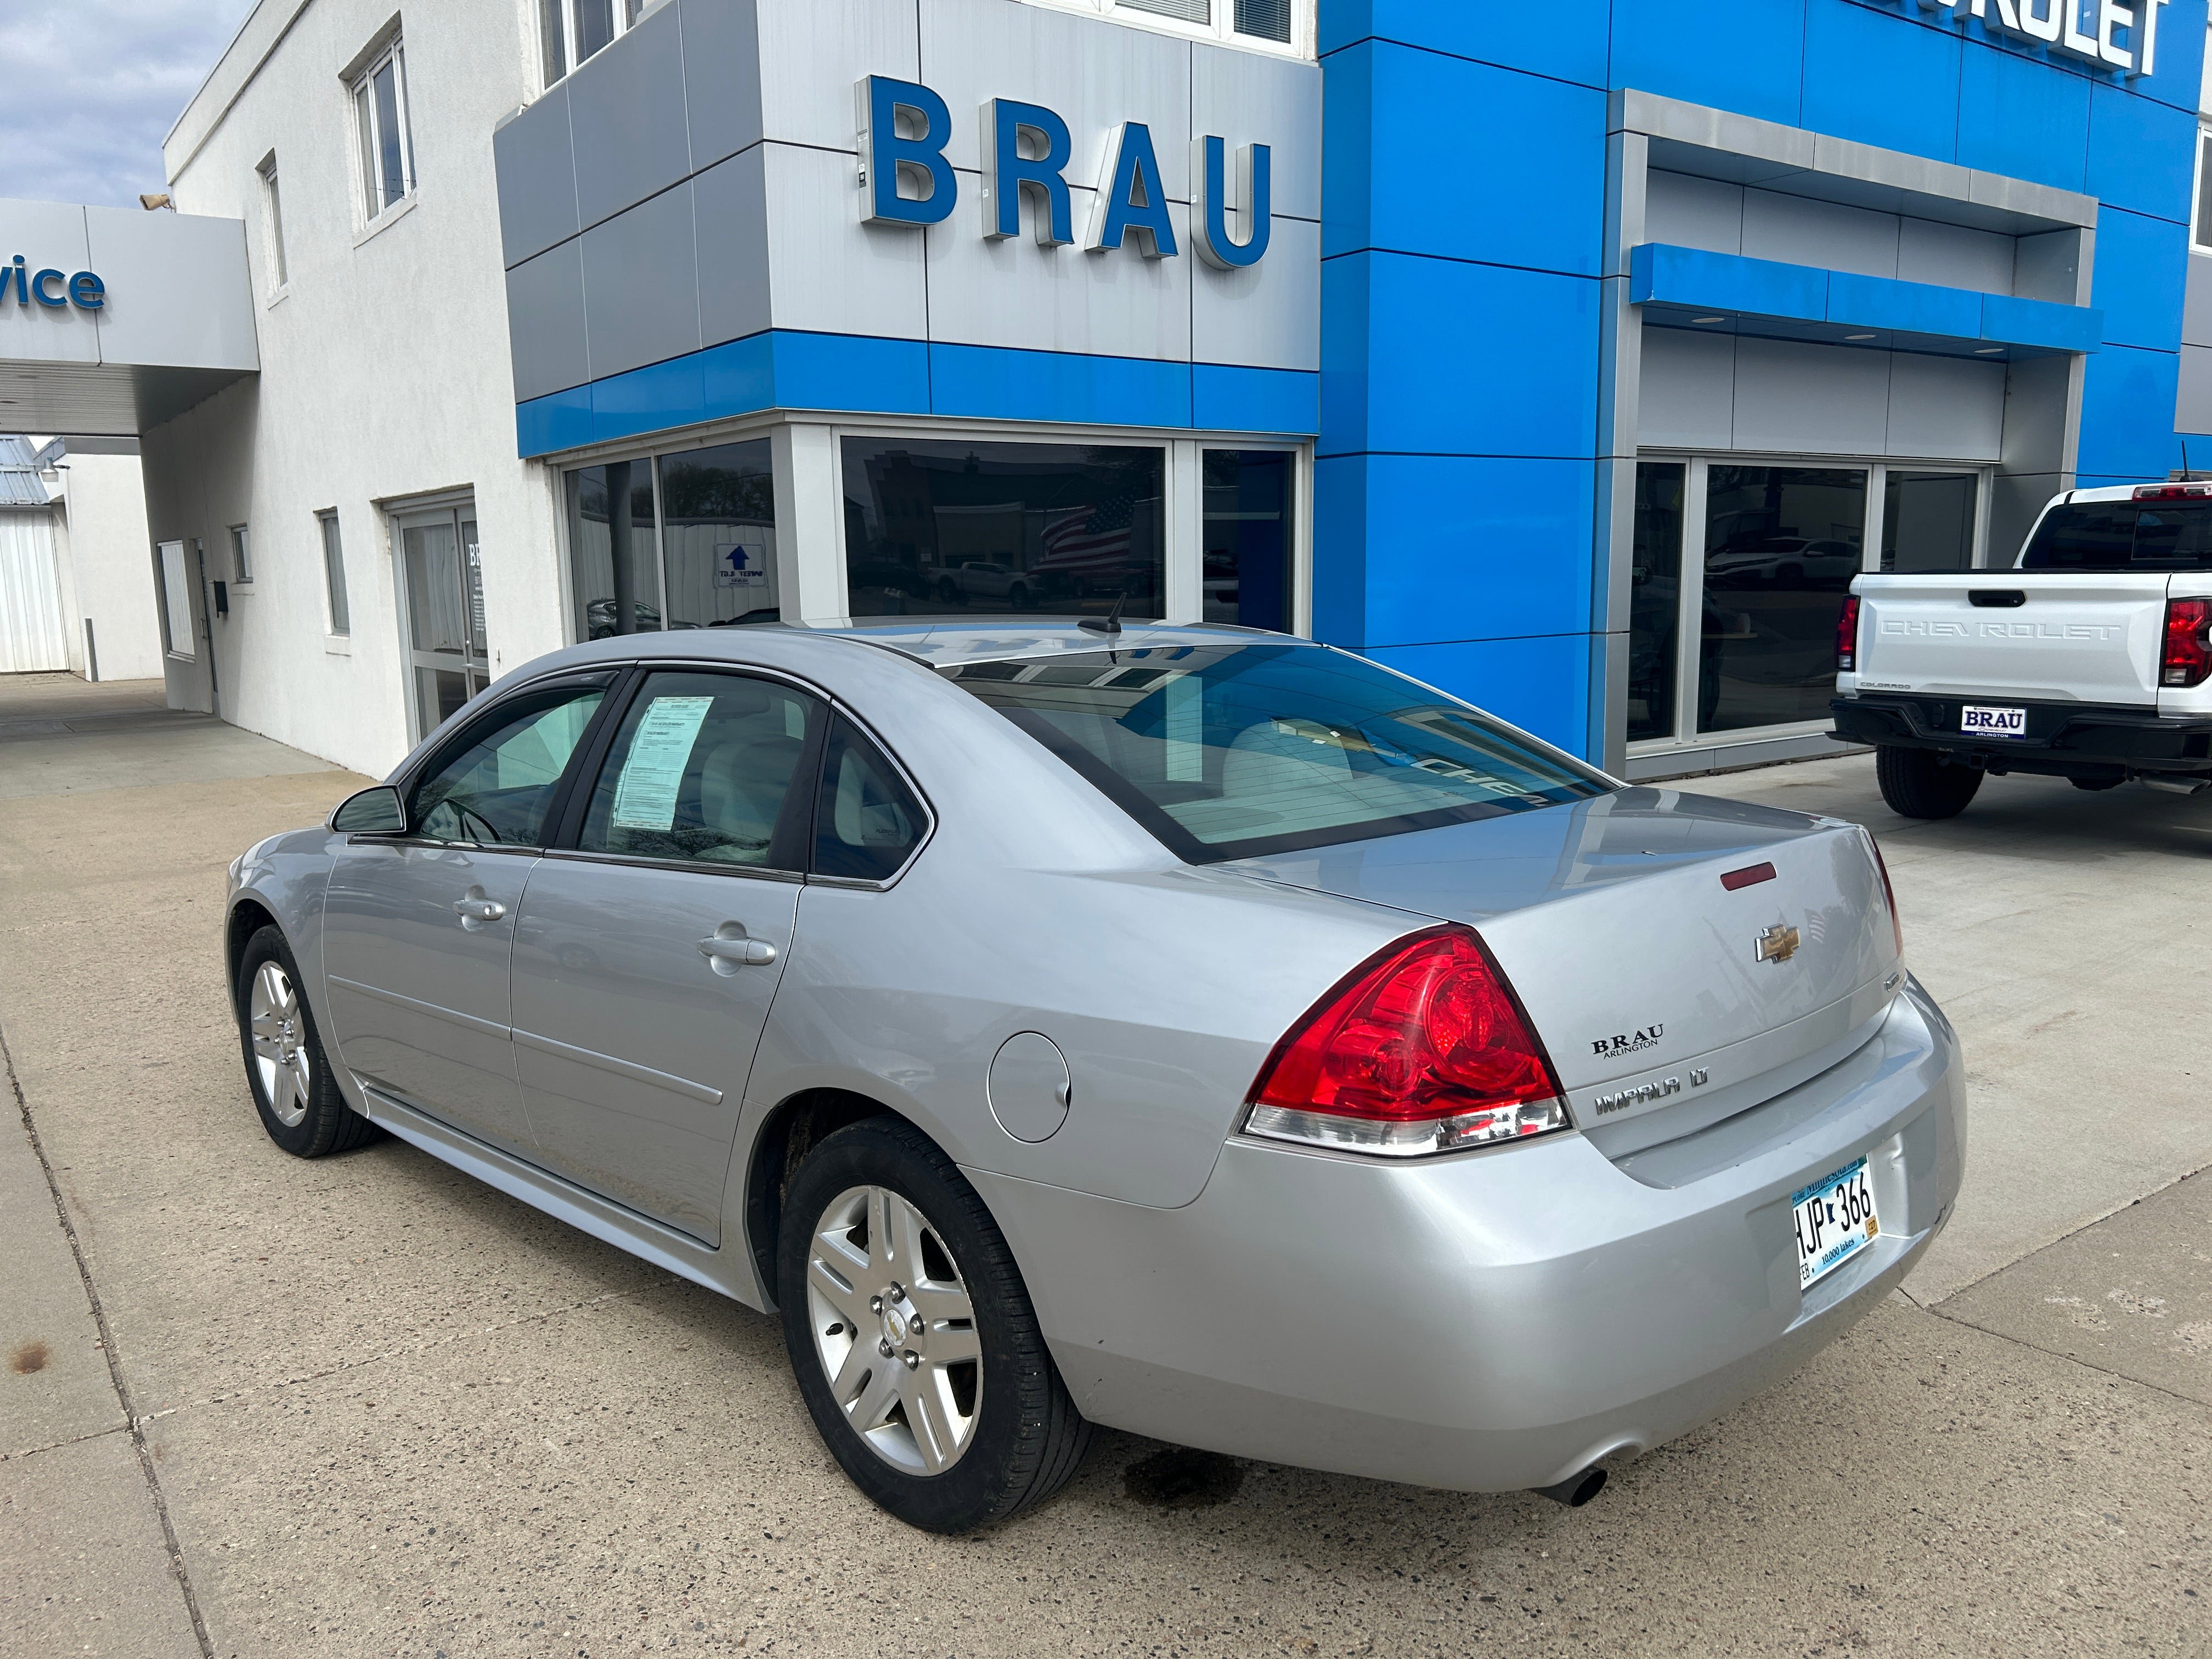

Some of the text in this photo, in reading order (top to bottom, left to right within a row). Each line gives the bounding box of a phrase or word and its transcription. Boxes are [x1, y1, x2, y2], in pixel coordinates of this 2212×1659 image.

[855, 74, 1271, 270] BRAU
[1881, 620, 2121, 640] CHEVROLET
[1860, 681, 1911, 690] COLORADO
[1965, 710, 2023, 729] BRAU
[1591, 1023, 1663, 1055] BRAU
[1603, 1039, 1658, 1060] ARLINGTON
[1595, 1066, 1709, 1116] IMPALA LT
[1836, 1171, 1871, 1232] 366
[1821, 1237, 1855, 1265] 10,000 lakes
